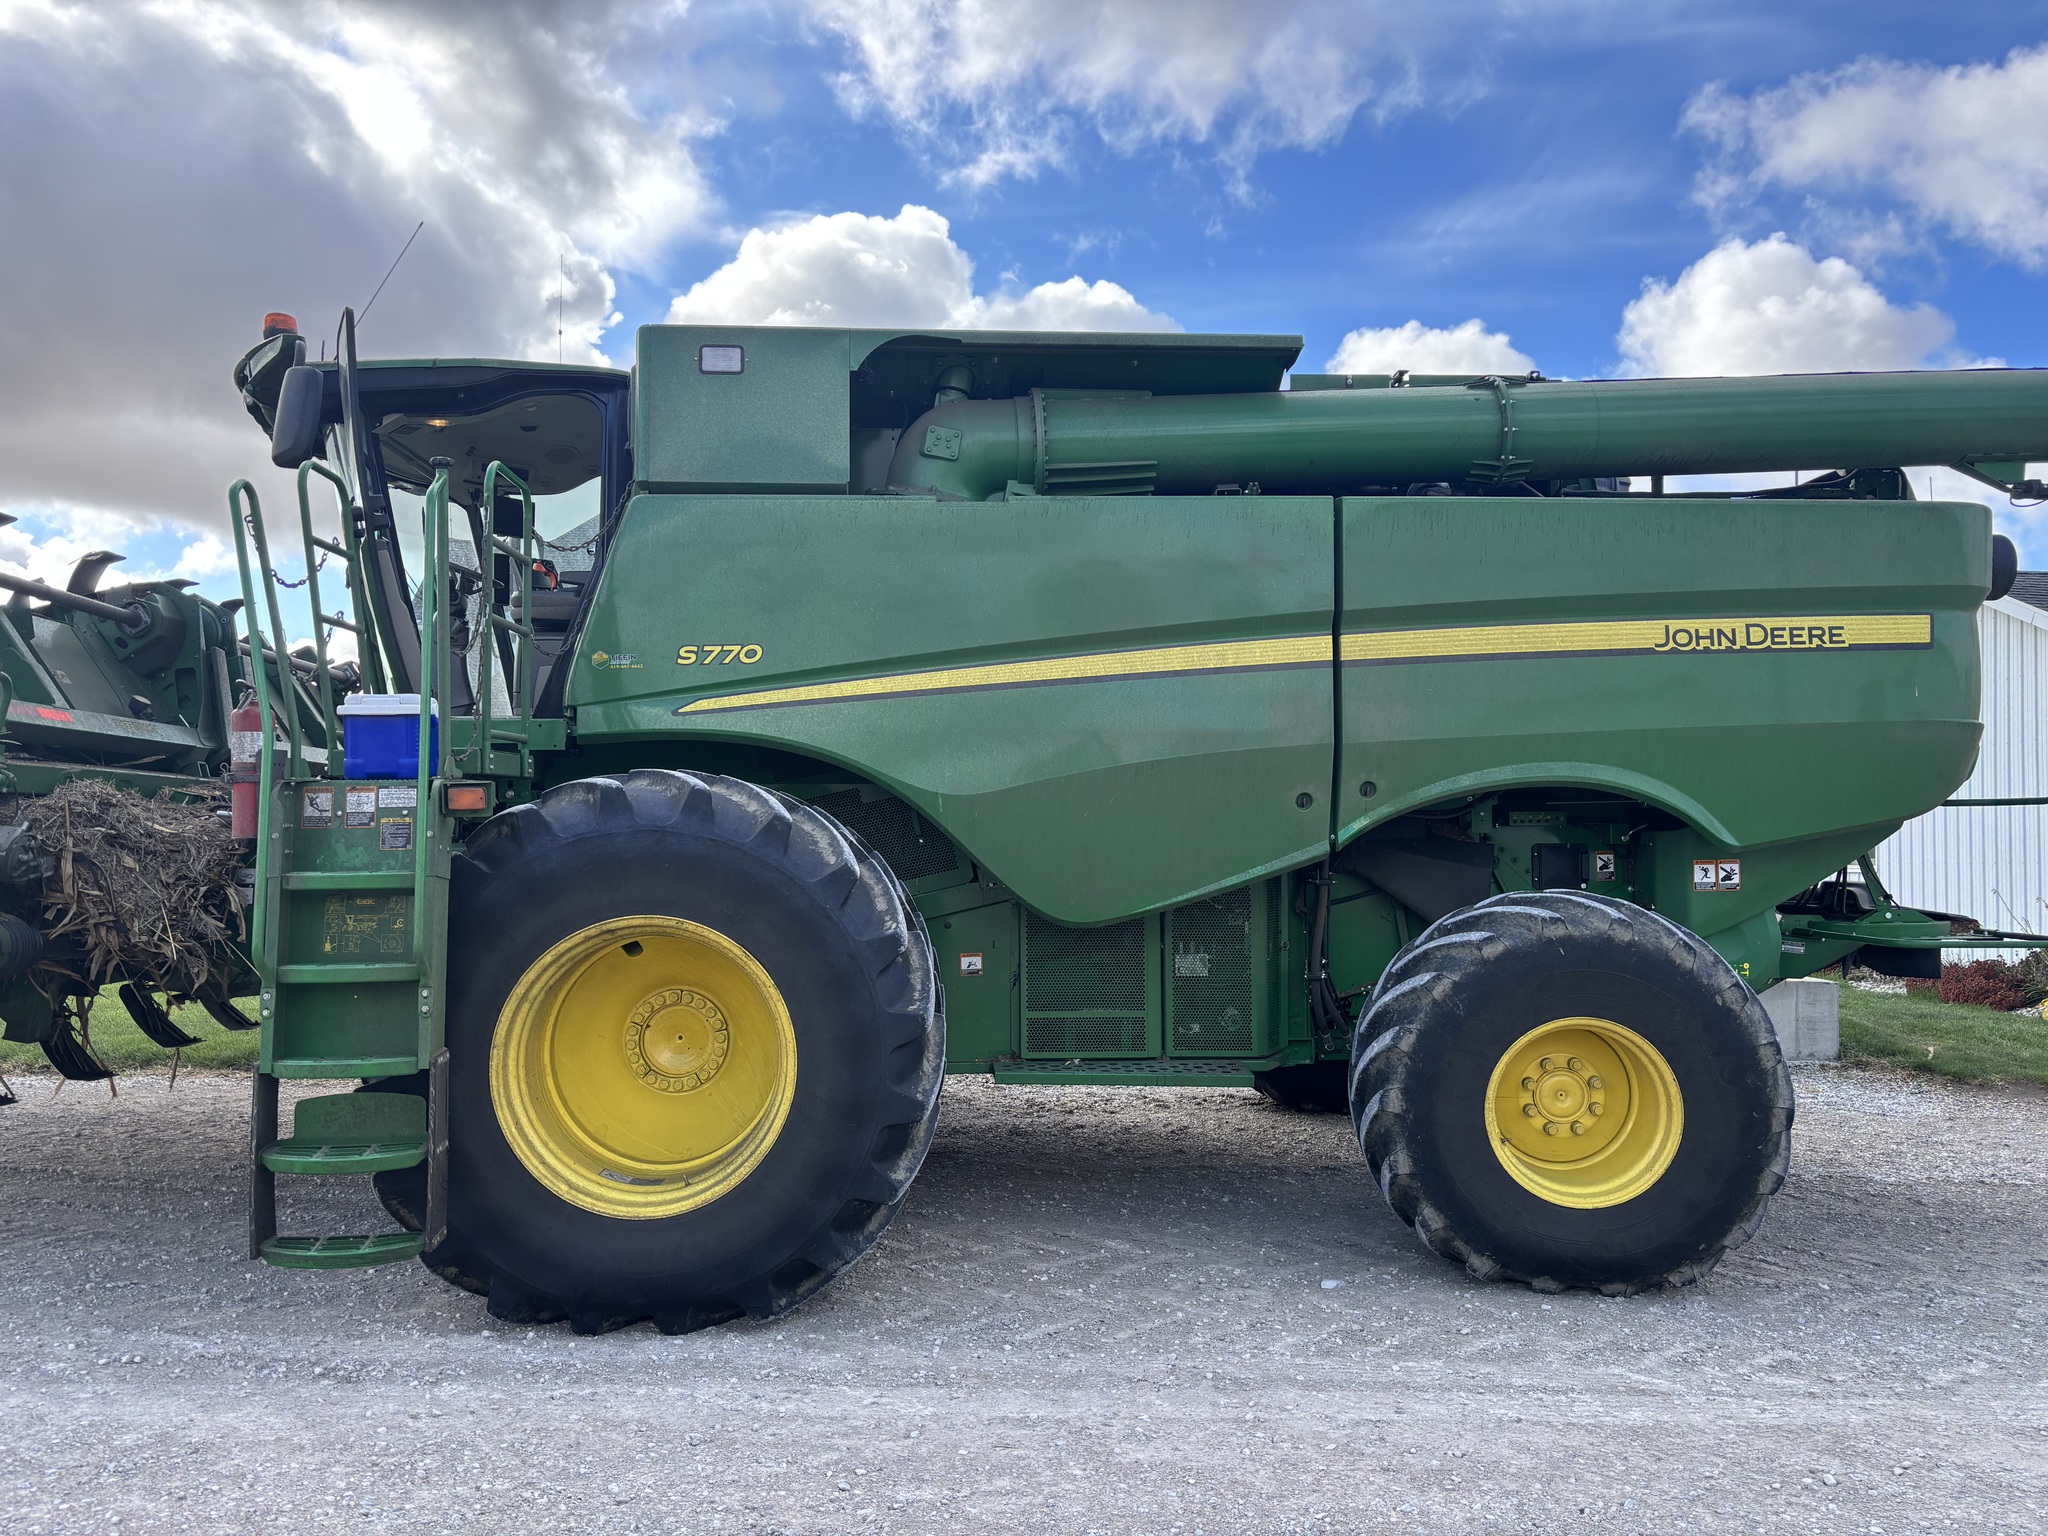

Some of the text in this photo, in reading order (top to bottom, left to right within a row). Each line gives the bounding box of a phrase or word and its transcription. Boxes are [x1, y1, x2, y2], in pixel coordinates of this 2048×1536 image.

[1654, 623, 1846, 648] JOHN DEERE
[676, 643, 764, 665] S770
